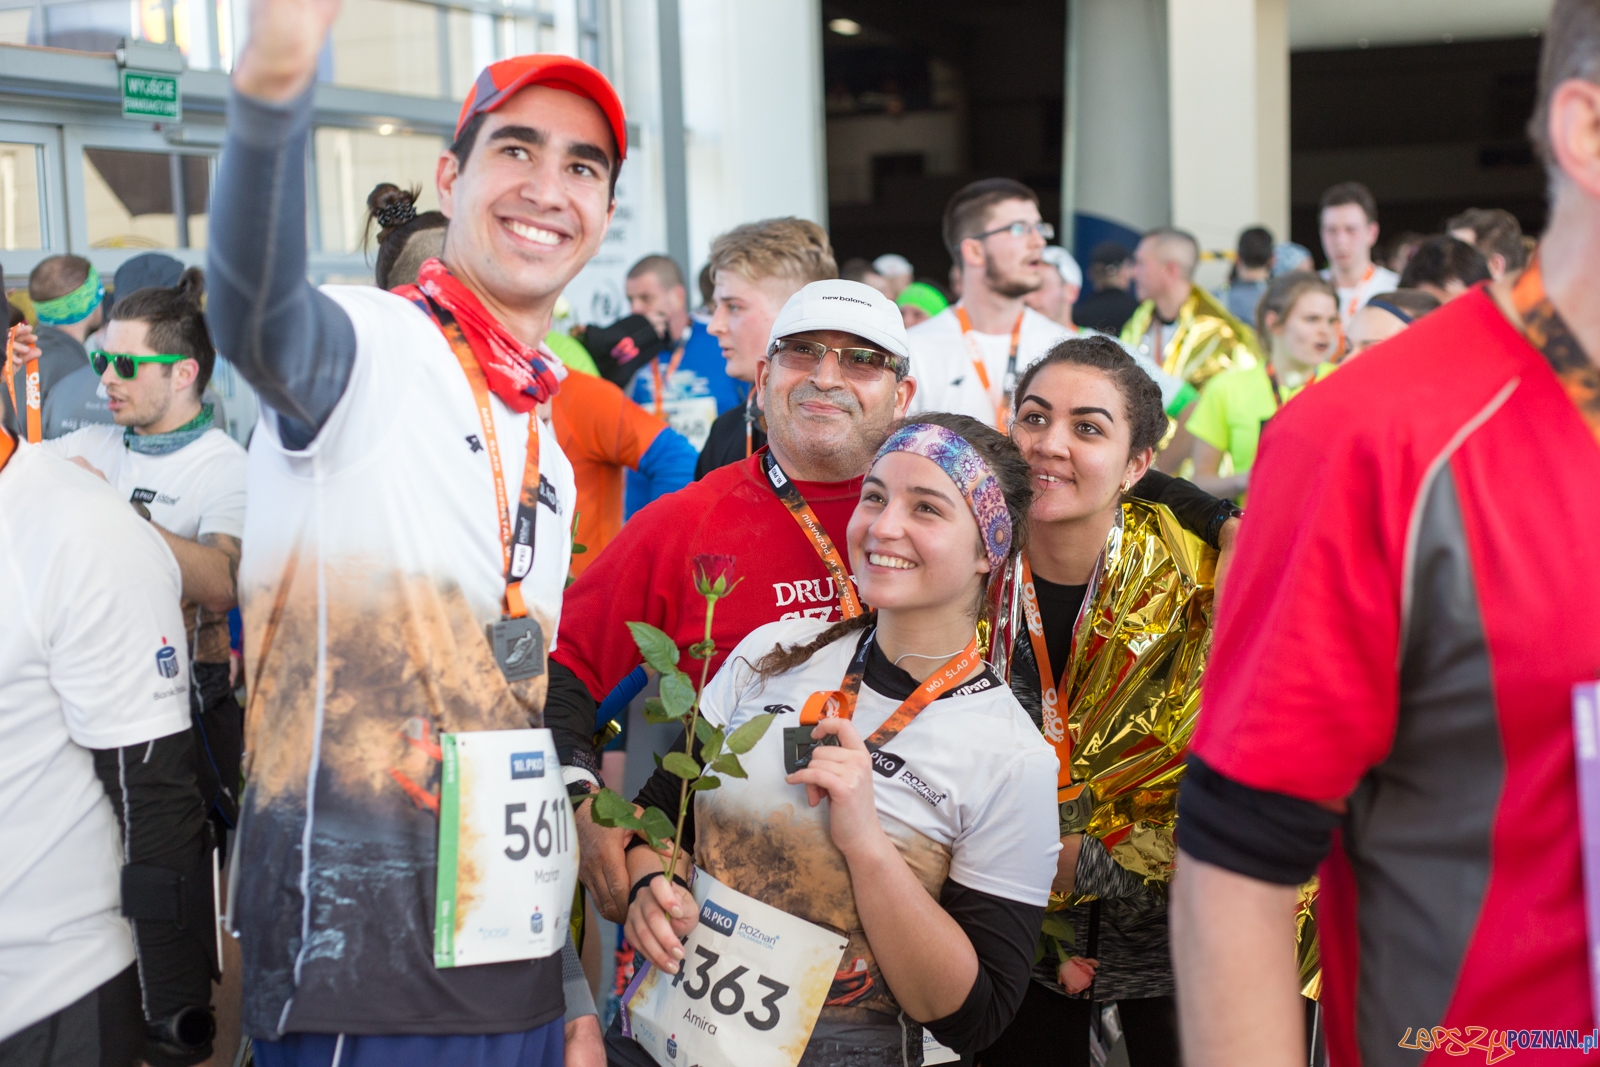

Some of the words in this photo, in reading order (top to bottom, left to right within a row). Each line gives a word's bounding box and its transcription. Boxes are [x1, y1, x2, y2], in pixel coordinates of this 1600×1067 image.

[839, 295, 873, 308] balance
[801, 513, 830, 555] POZNANIU
[829, 558, 838, 567] W
[925, 677, 945, 694] MÓJ
[945, 658, 969, 680] ŚLAD
[504, 797, 568, 861] 5611
[682, 1007, 718, 1036] Amira
